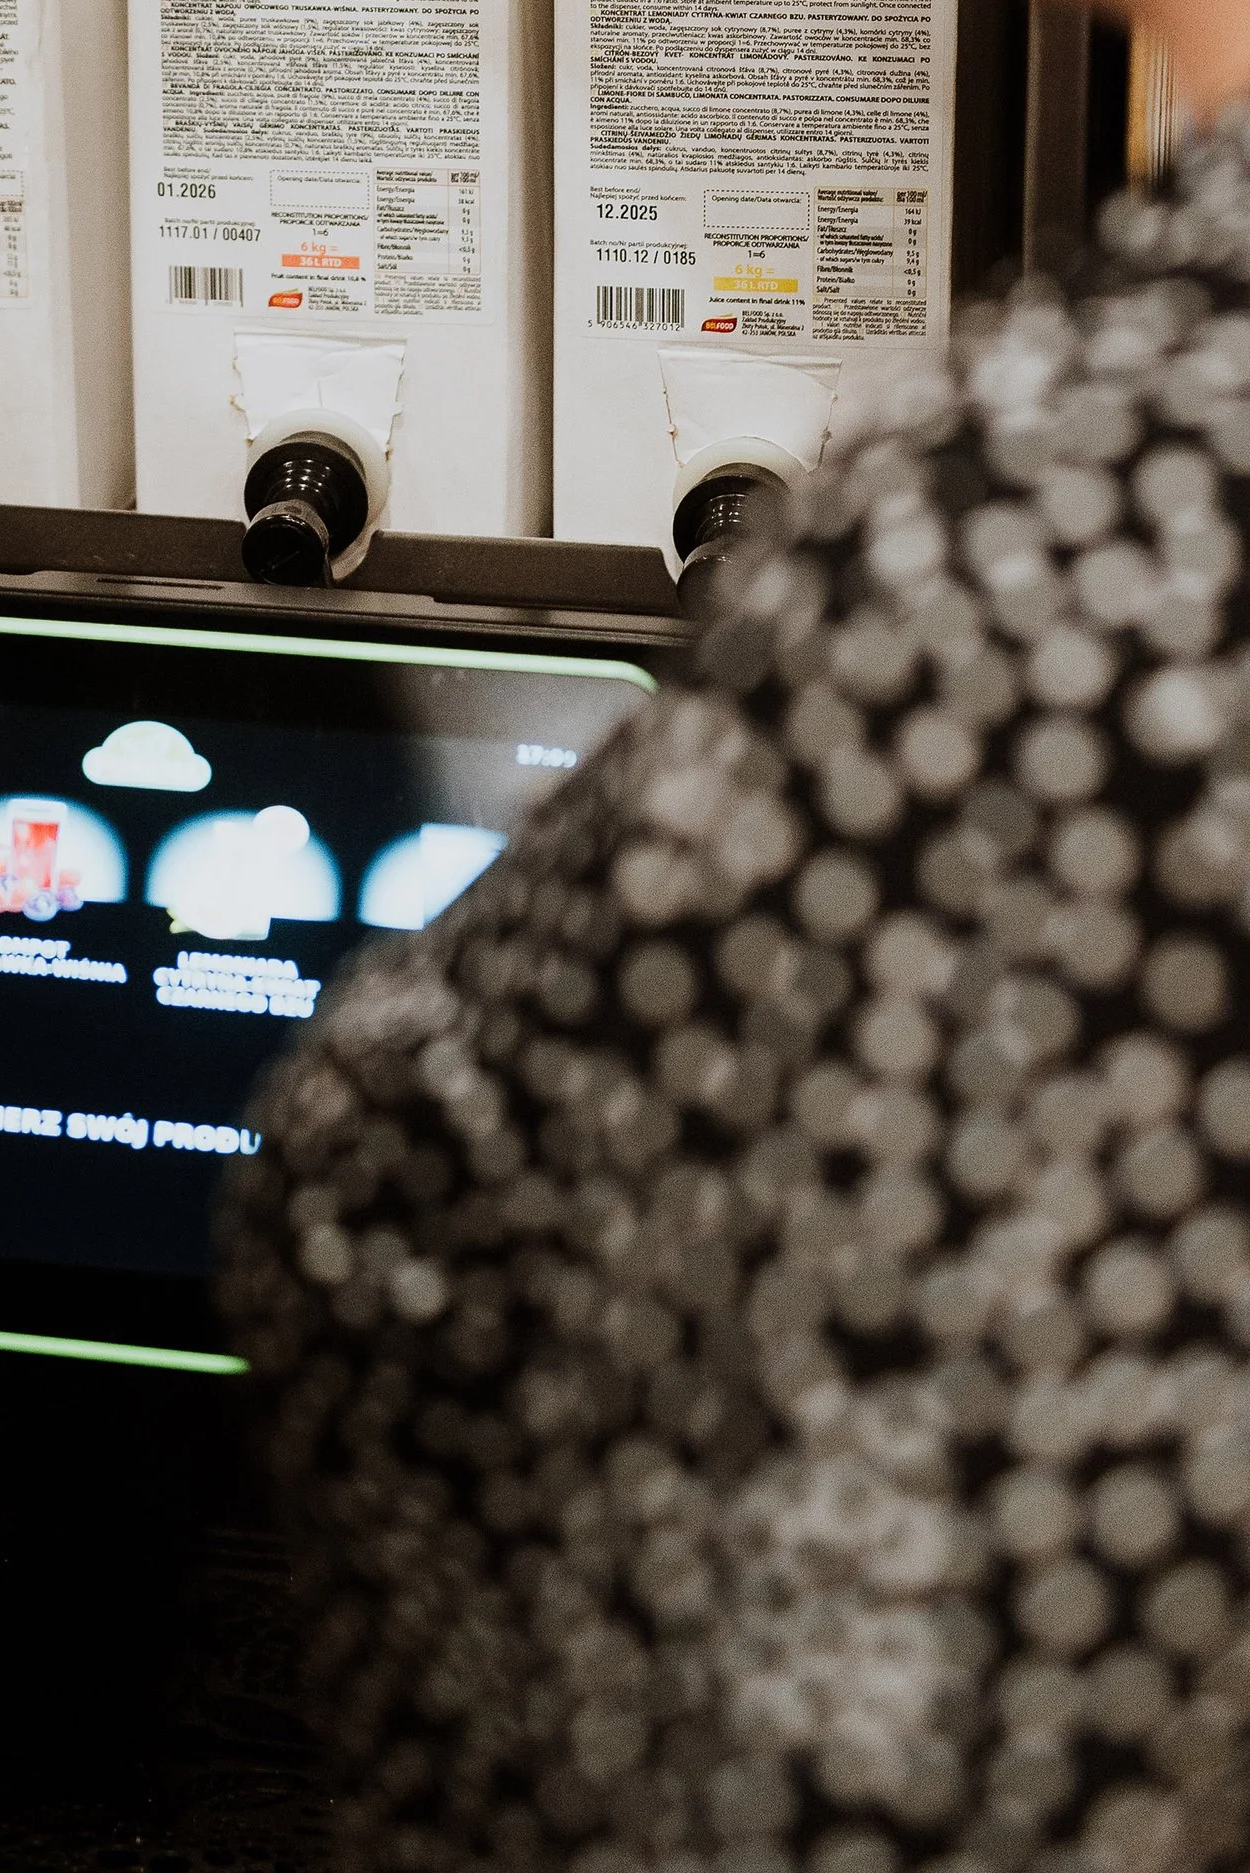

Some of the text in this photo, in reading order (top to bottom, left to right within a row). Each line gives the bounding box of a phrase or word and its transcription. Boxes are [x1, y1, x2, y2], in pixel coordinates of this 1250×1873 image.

[157, 182, 216, 198] 01.2026
[712, 195, 739, 203] Opening
[741, 195, 772, 203] date/Data
[597, 204, 657, 220] 12.2025
[159, 225, 207, 239] 1117.01
[223, 228, 261, 241] 00407
[761, 234, 809, 242] PROPORTIONS/
[301, 242, 308, 251] 6
[312, 242, 326, 254] kg
[713, 240, 750, 248] PROPORCJE
[597, 249, 648, 263] 1110.12
[664, 251, 696, 265] 0185
[748, 250, 765, 259] 1=6
[735, 264, 743, 274] 6
[747, 264, 762, 277] kg
[600, 321, 637, 329] 906546
[644, 322, 680, 332] 327012
[706, 322, 734, 330] BELFOOD
[153, 1122, 260, 1155] PRODU
